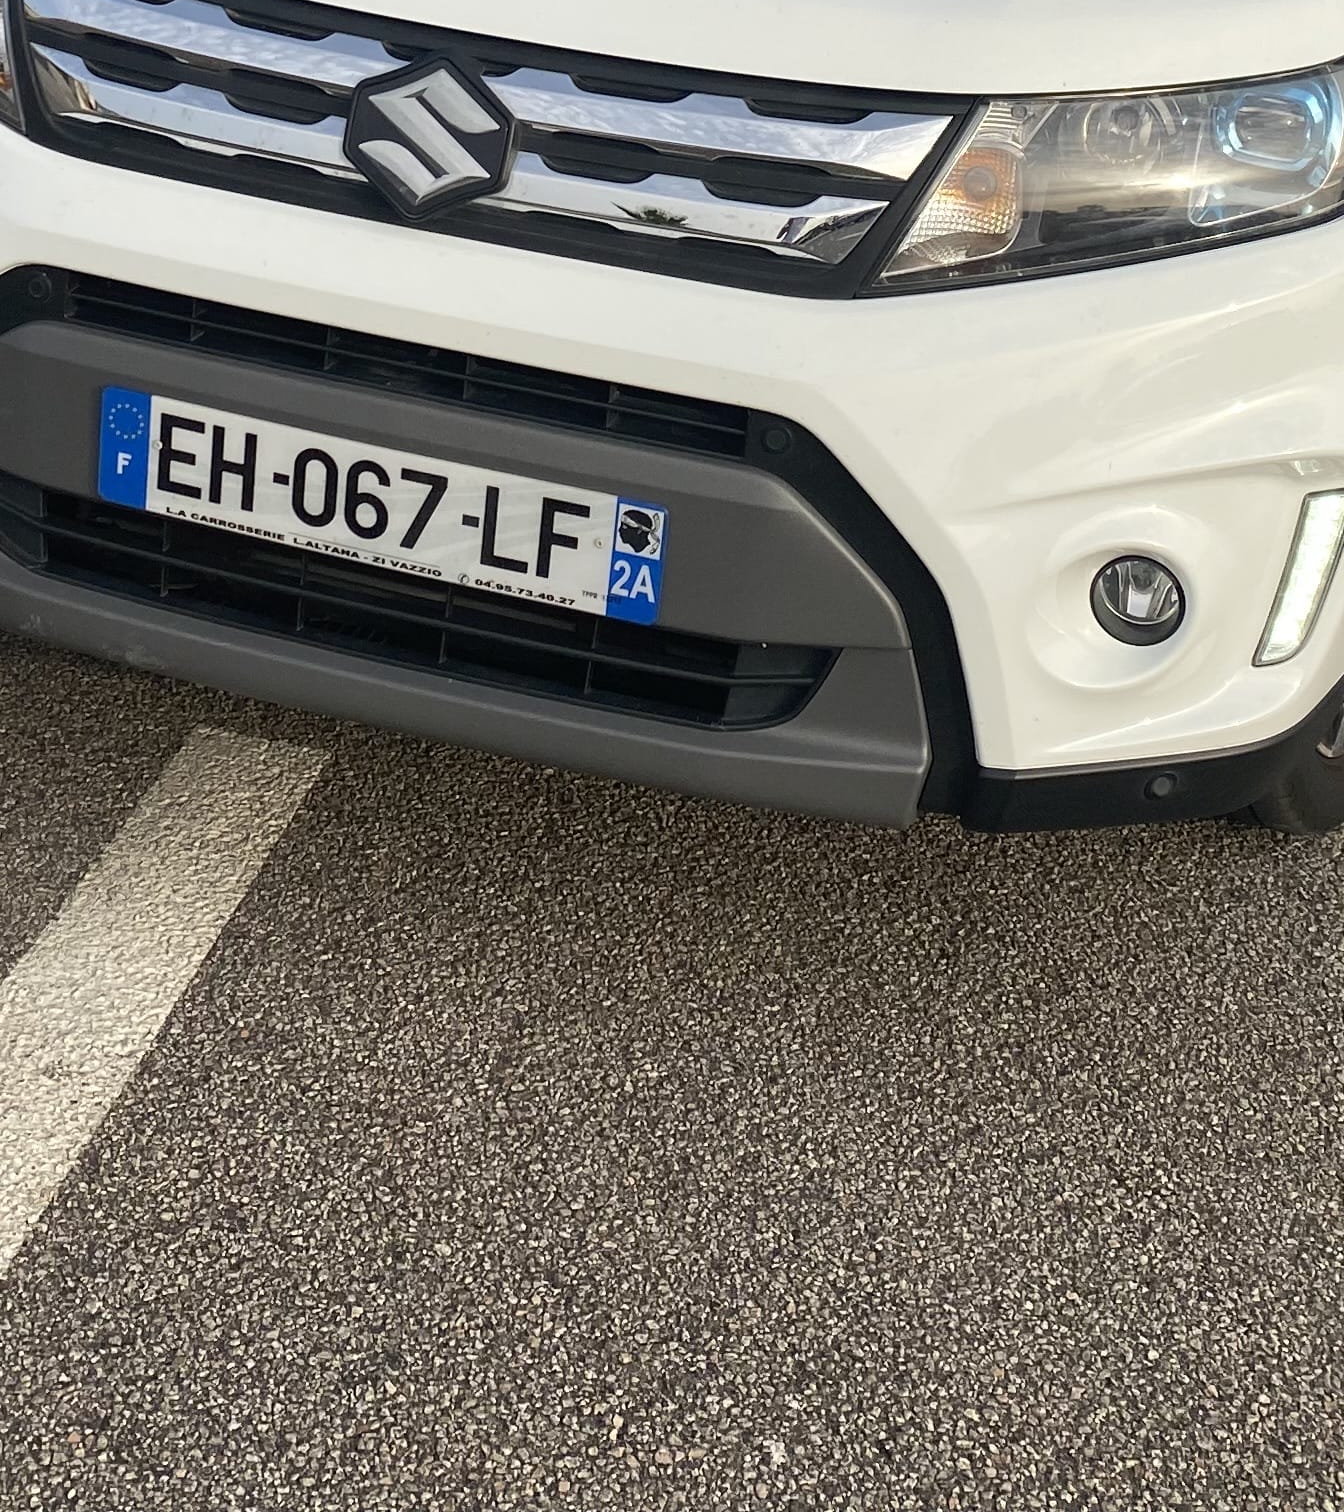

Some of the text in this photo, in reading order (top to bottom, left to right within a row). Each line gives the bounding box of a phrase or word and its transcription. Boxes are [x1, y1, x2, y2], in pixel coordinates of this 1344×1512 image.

[116, 452, 132, 476] F
[157, 412, 590, 579] EH-067-LF
[190, 513, 285, 541] CARROSSERIE
[372, 556, 386, 565] ZI
[389, 560, 442, 578] VAZZIO
[474, 578, 576, 606] 04.95.73.40.27
[610, 559, 656, 604] 2A
